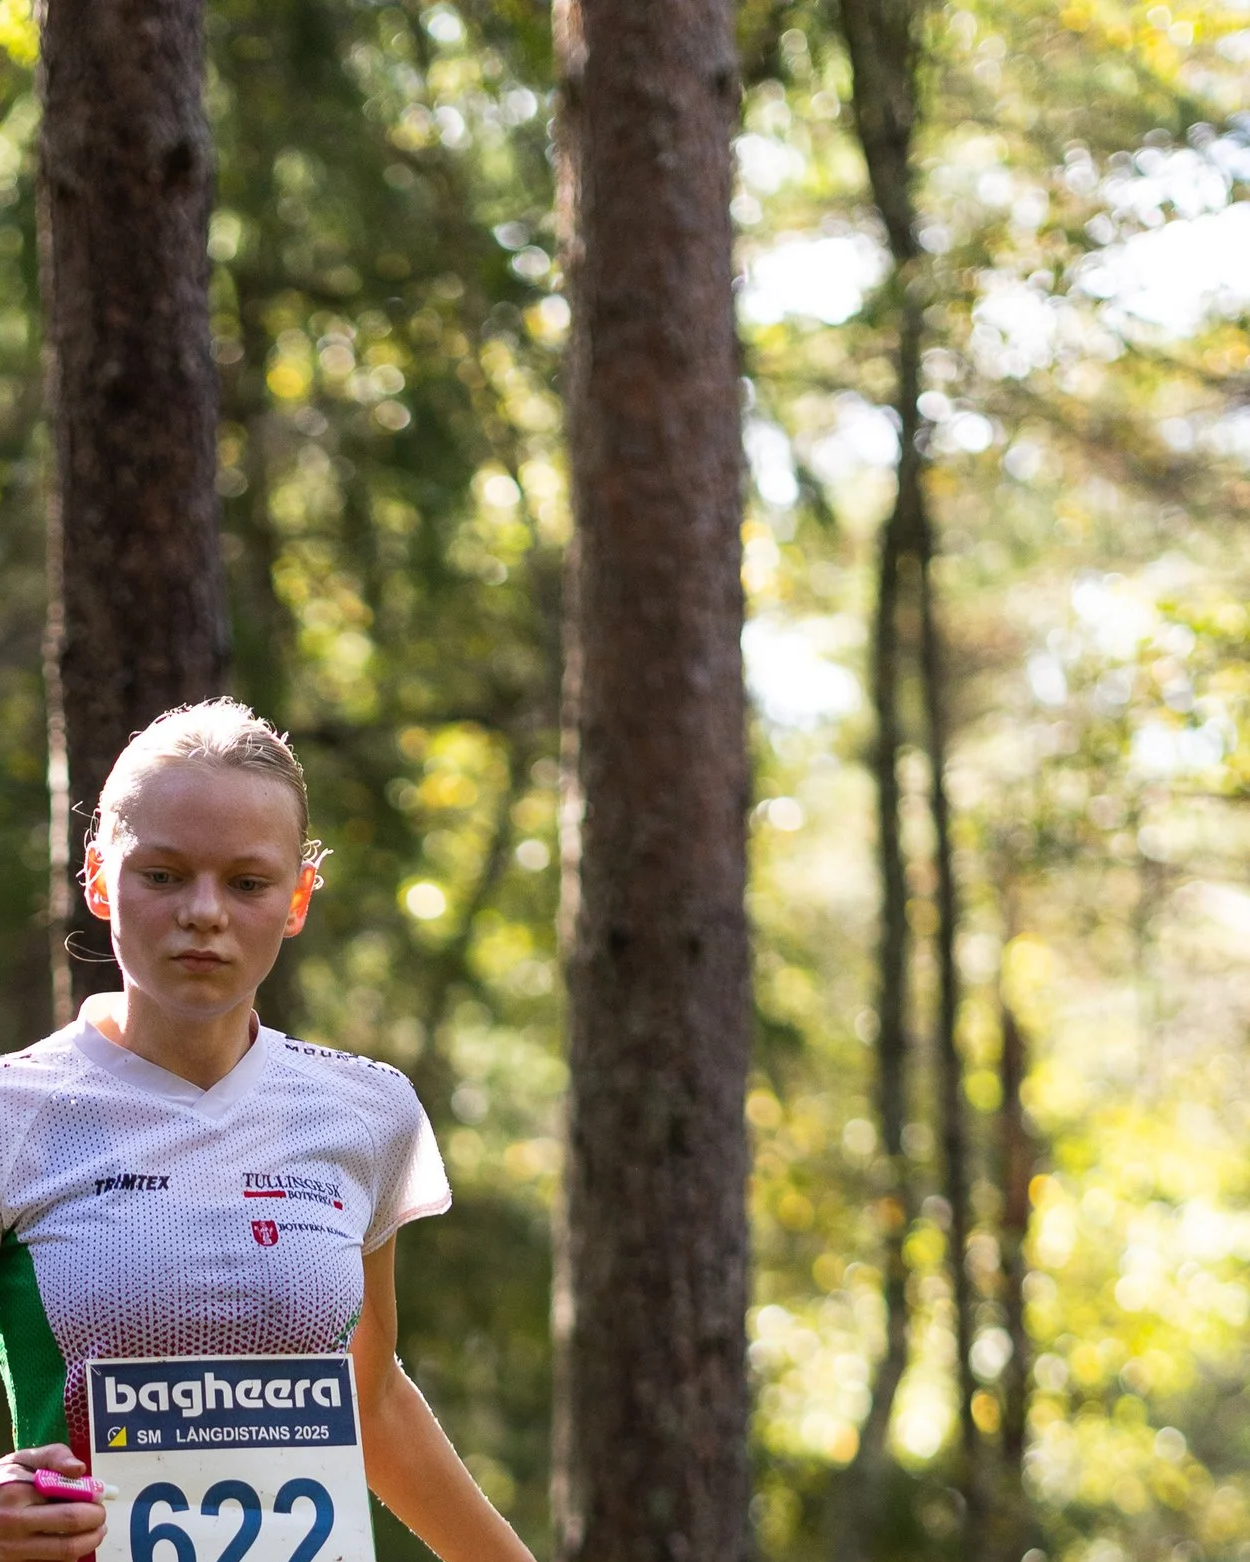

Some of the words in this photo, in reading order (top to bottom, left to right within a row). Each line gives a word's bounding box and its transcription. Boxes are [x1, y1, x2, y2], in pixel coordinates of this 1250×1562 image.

[94, 1173, 170, 1196] TRIMTEX
[105, 1372, 342, 1418] bagheera
[137, 1430, 162, 1444] SM
[176, 1425, 291, 1443] LÅNGDISTANS
[294, 1426, 330, 1441] 2025
